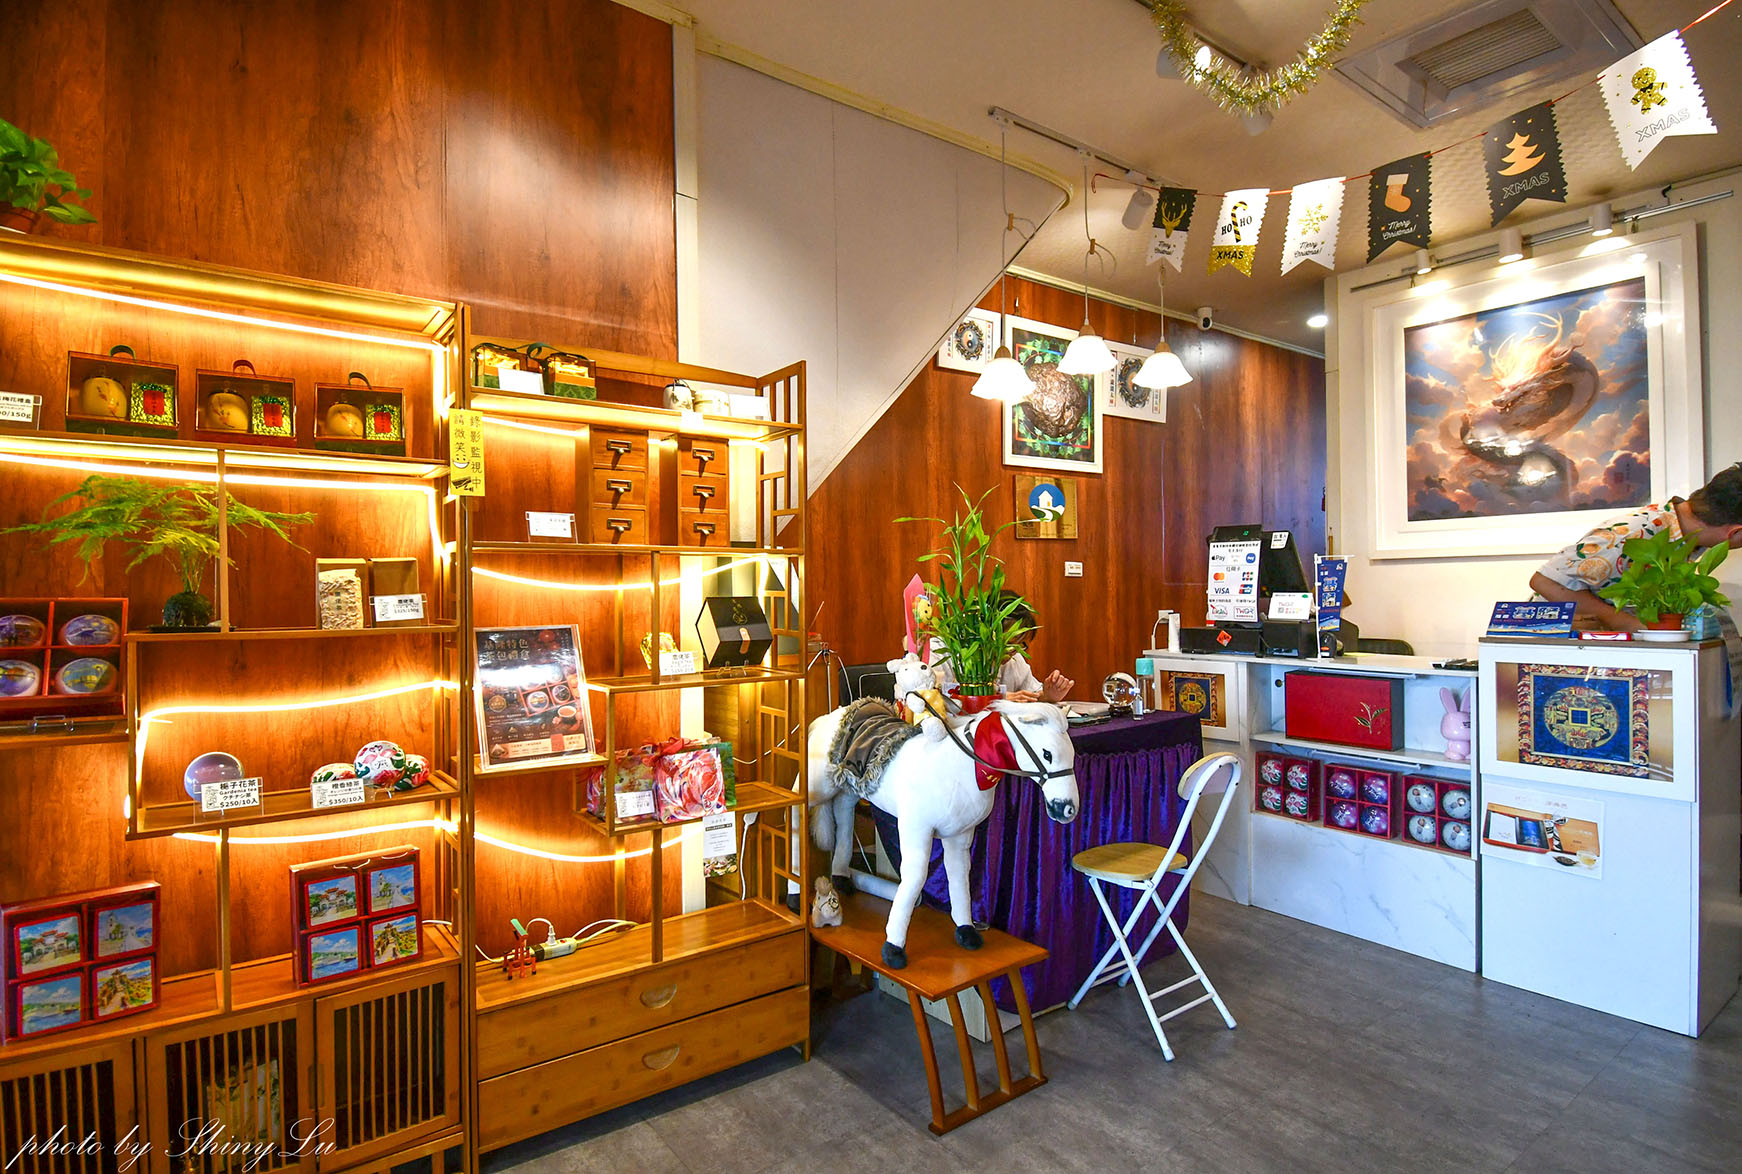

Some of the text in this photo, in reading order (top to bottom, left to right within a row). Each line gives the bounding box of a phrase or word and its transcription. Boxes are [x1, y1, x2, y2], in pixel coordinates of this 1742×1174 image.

[1635, 108, 1690, 143] XMAS
[1502, 172, 1550, 200] XMAS
[1221, 215, 1253, 236] HO HO
[1216, 250, 1244, 260] XMAS
[0, 411, 31, 419] 0/150g
